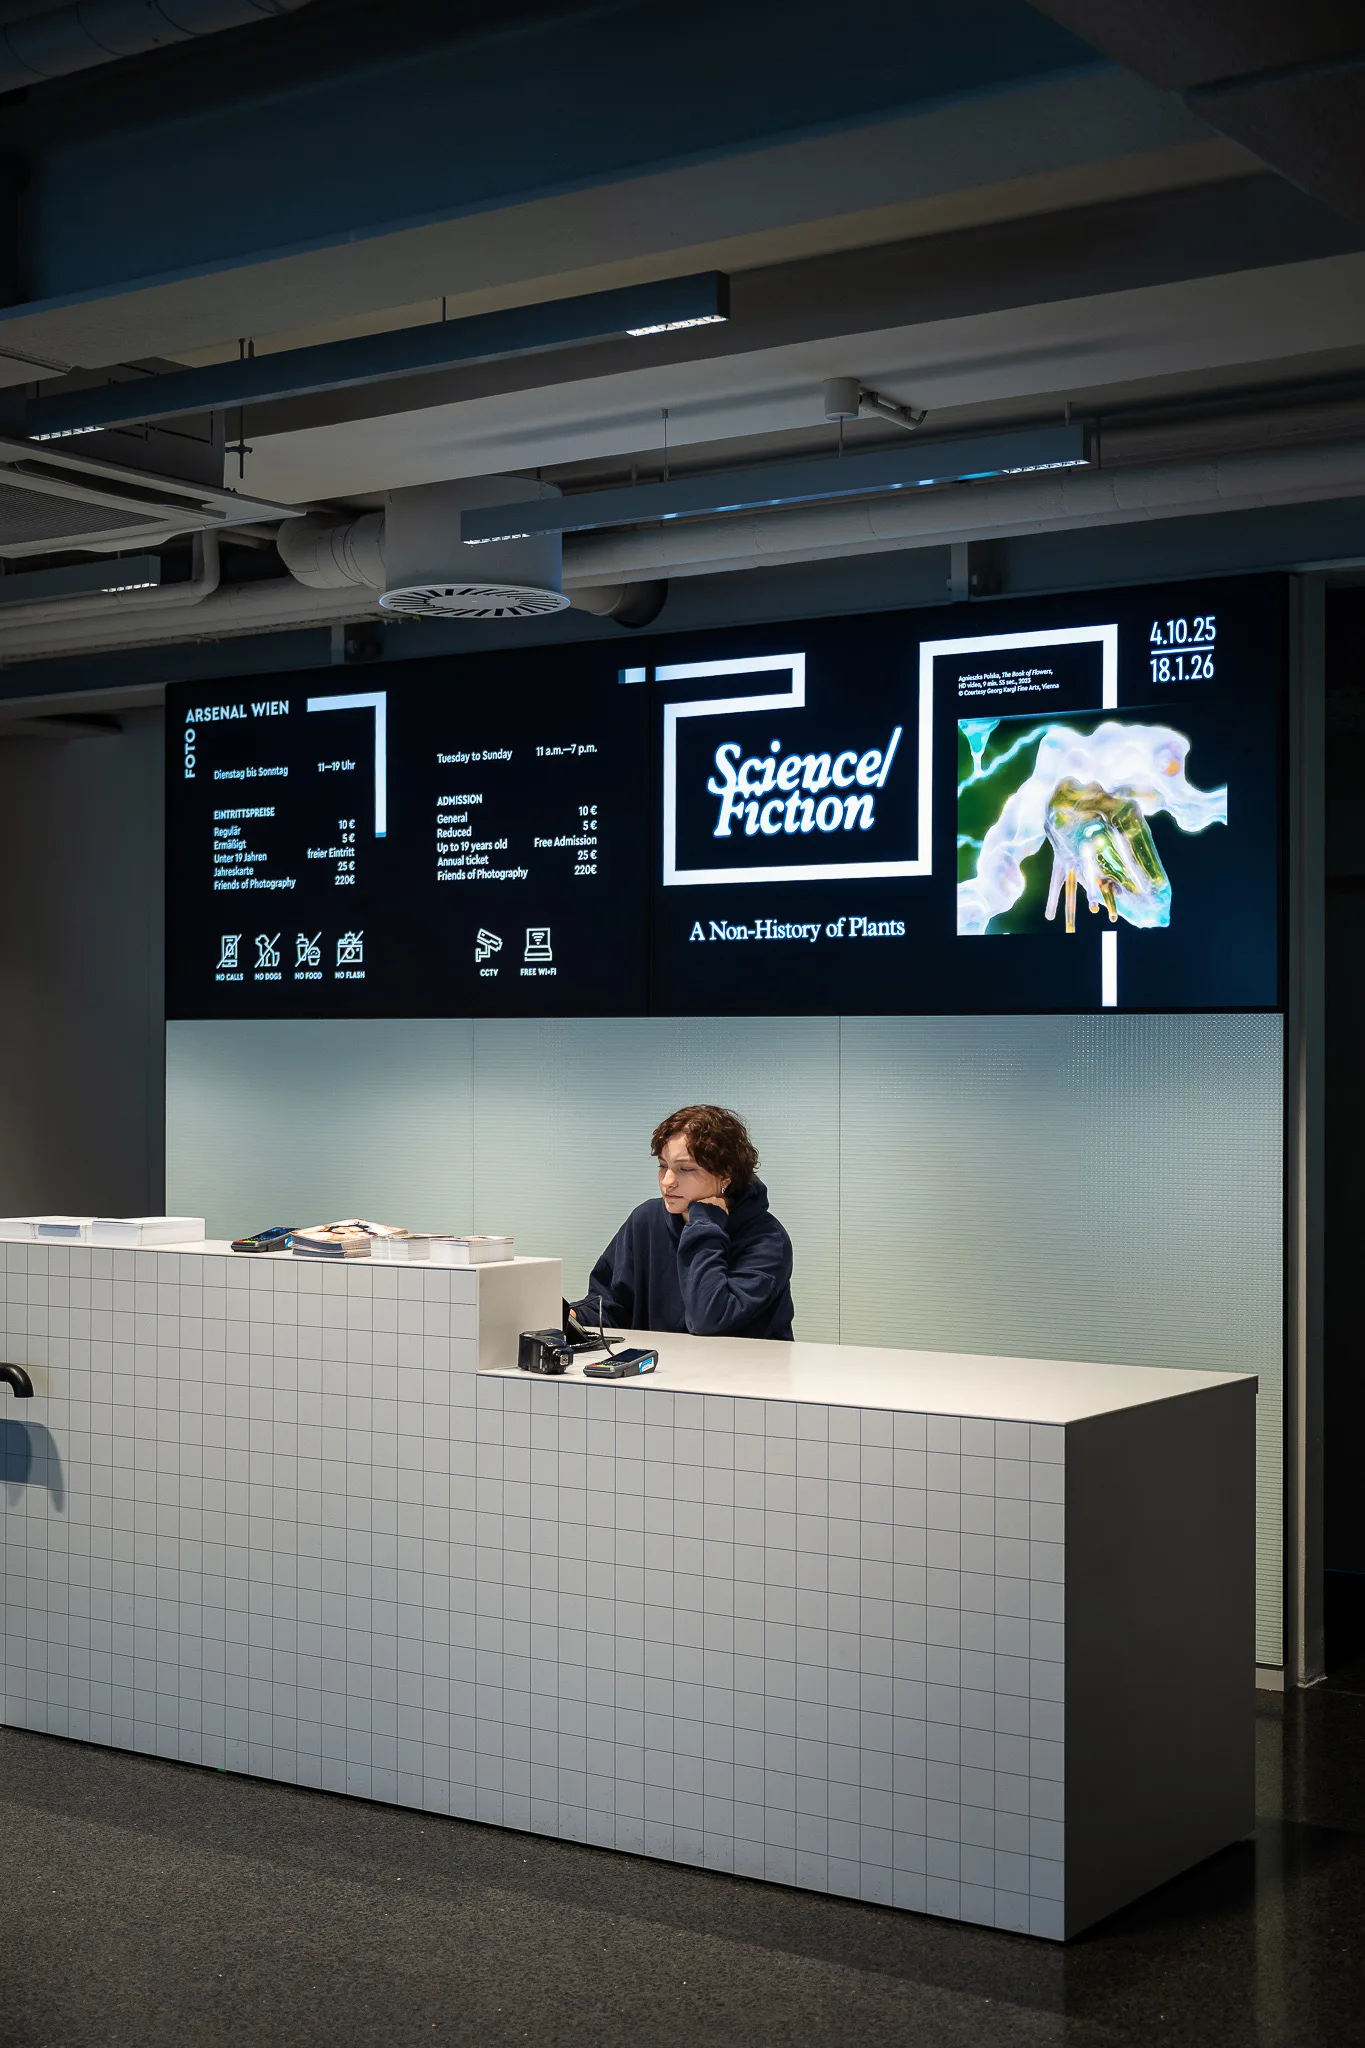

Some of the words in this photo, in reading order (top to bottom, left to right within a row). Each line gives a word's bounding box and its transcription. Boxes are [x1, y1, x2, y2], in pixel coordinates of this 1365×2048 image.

[1150, 616, 1217, 645] 4.10.25
[1150, 654, 1214, 682] 18.1.26
[959, 674, 982, 682] Agnieszka
[185, 704, 247, 723] ARSENAL
[251, 700, 289, 717] WIEN
[185, 728, 196, 778] FOTO
[437, 752, 470, 764] Tuesday
[472, 751, 480, 761] to
[482, 749, 512, 761] Sunday
[536, 747, 544, 756] 11
[578, 744, 597, 755] p.m.
[214, 768, 244, 779] Dienstag
[246, 767, 257, 777] bis
[258, 766, 288, 776] Sonntag
[342, 760, 355, 770] Uhr
[437, 794, 483, 806] ADMISSION
[214, 807, 275, 820] EINTRITTSPREISE
[437, 812, 467, 824] General
[578, 806, 588, 816] 10
[590, 805, 597, 816] €
[713, 790, 876, 838] Fiction
[214, 825, 241, 838] Regulär
[338, 819, 347, 829] 10
[349, 819, 355, 829] €
[437, 826, 472, 838] Reduced
[583, 820, 588, 830] 5
[590, 820, 597, 830] €
[214, 839, 246, 850] Ermäßigt
[342, 833, 347, 843] 5
[349, 832, 355, 843] €
[437, 842, 448, 854] Up
[450, 842, 459, 852] to
[461, 841, 469, 851] 19
[471, 840, 492, 852] years
[494, 838, 507, 850] old
[534, 837, 552, 848] Free
[554, 835, 597, 847] Admission
[214, 854, 234, 863] Unter
[235, 853, 242, 862] 19
[243, 852, 267, 862] Jahren
[307, 849, 327, 859] freier
[329, 848, 355, 858] Eintritt
[437, 855, 464, 867] Annual
[466, 855, 488, 865] ticket
[577, 850, 588, 861] 25
[590, 850, 597, 860] €
[214, 866, 253, 877] Jahreskarte
[338, 862, 347, 871] 25
[349, 861, 355, 871] €
[437, 870, 465, 881] Friends
[467, 869, 476, 880] of
[477, 867, 528, 880] Photography
[214, 881, 239, 890] Friends
[241, 880, 248, 889] of
[250, 877, 296, 890] Photography
[689, 922, 705, 941] A
[709, 918, 821, 942] Non-History
[826, 917, 846, 938] of
[848, 916, 905, 938] Plants
[480, 968, 498, 977] CCTV
[520, 968, 536, 976] FREE
